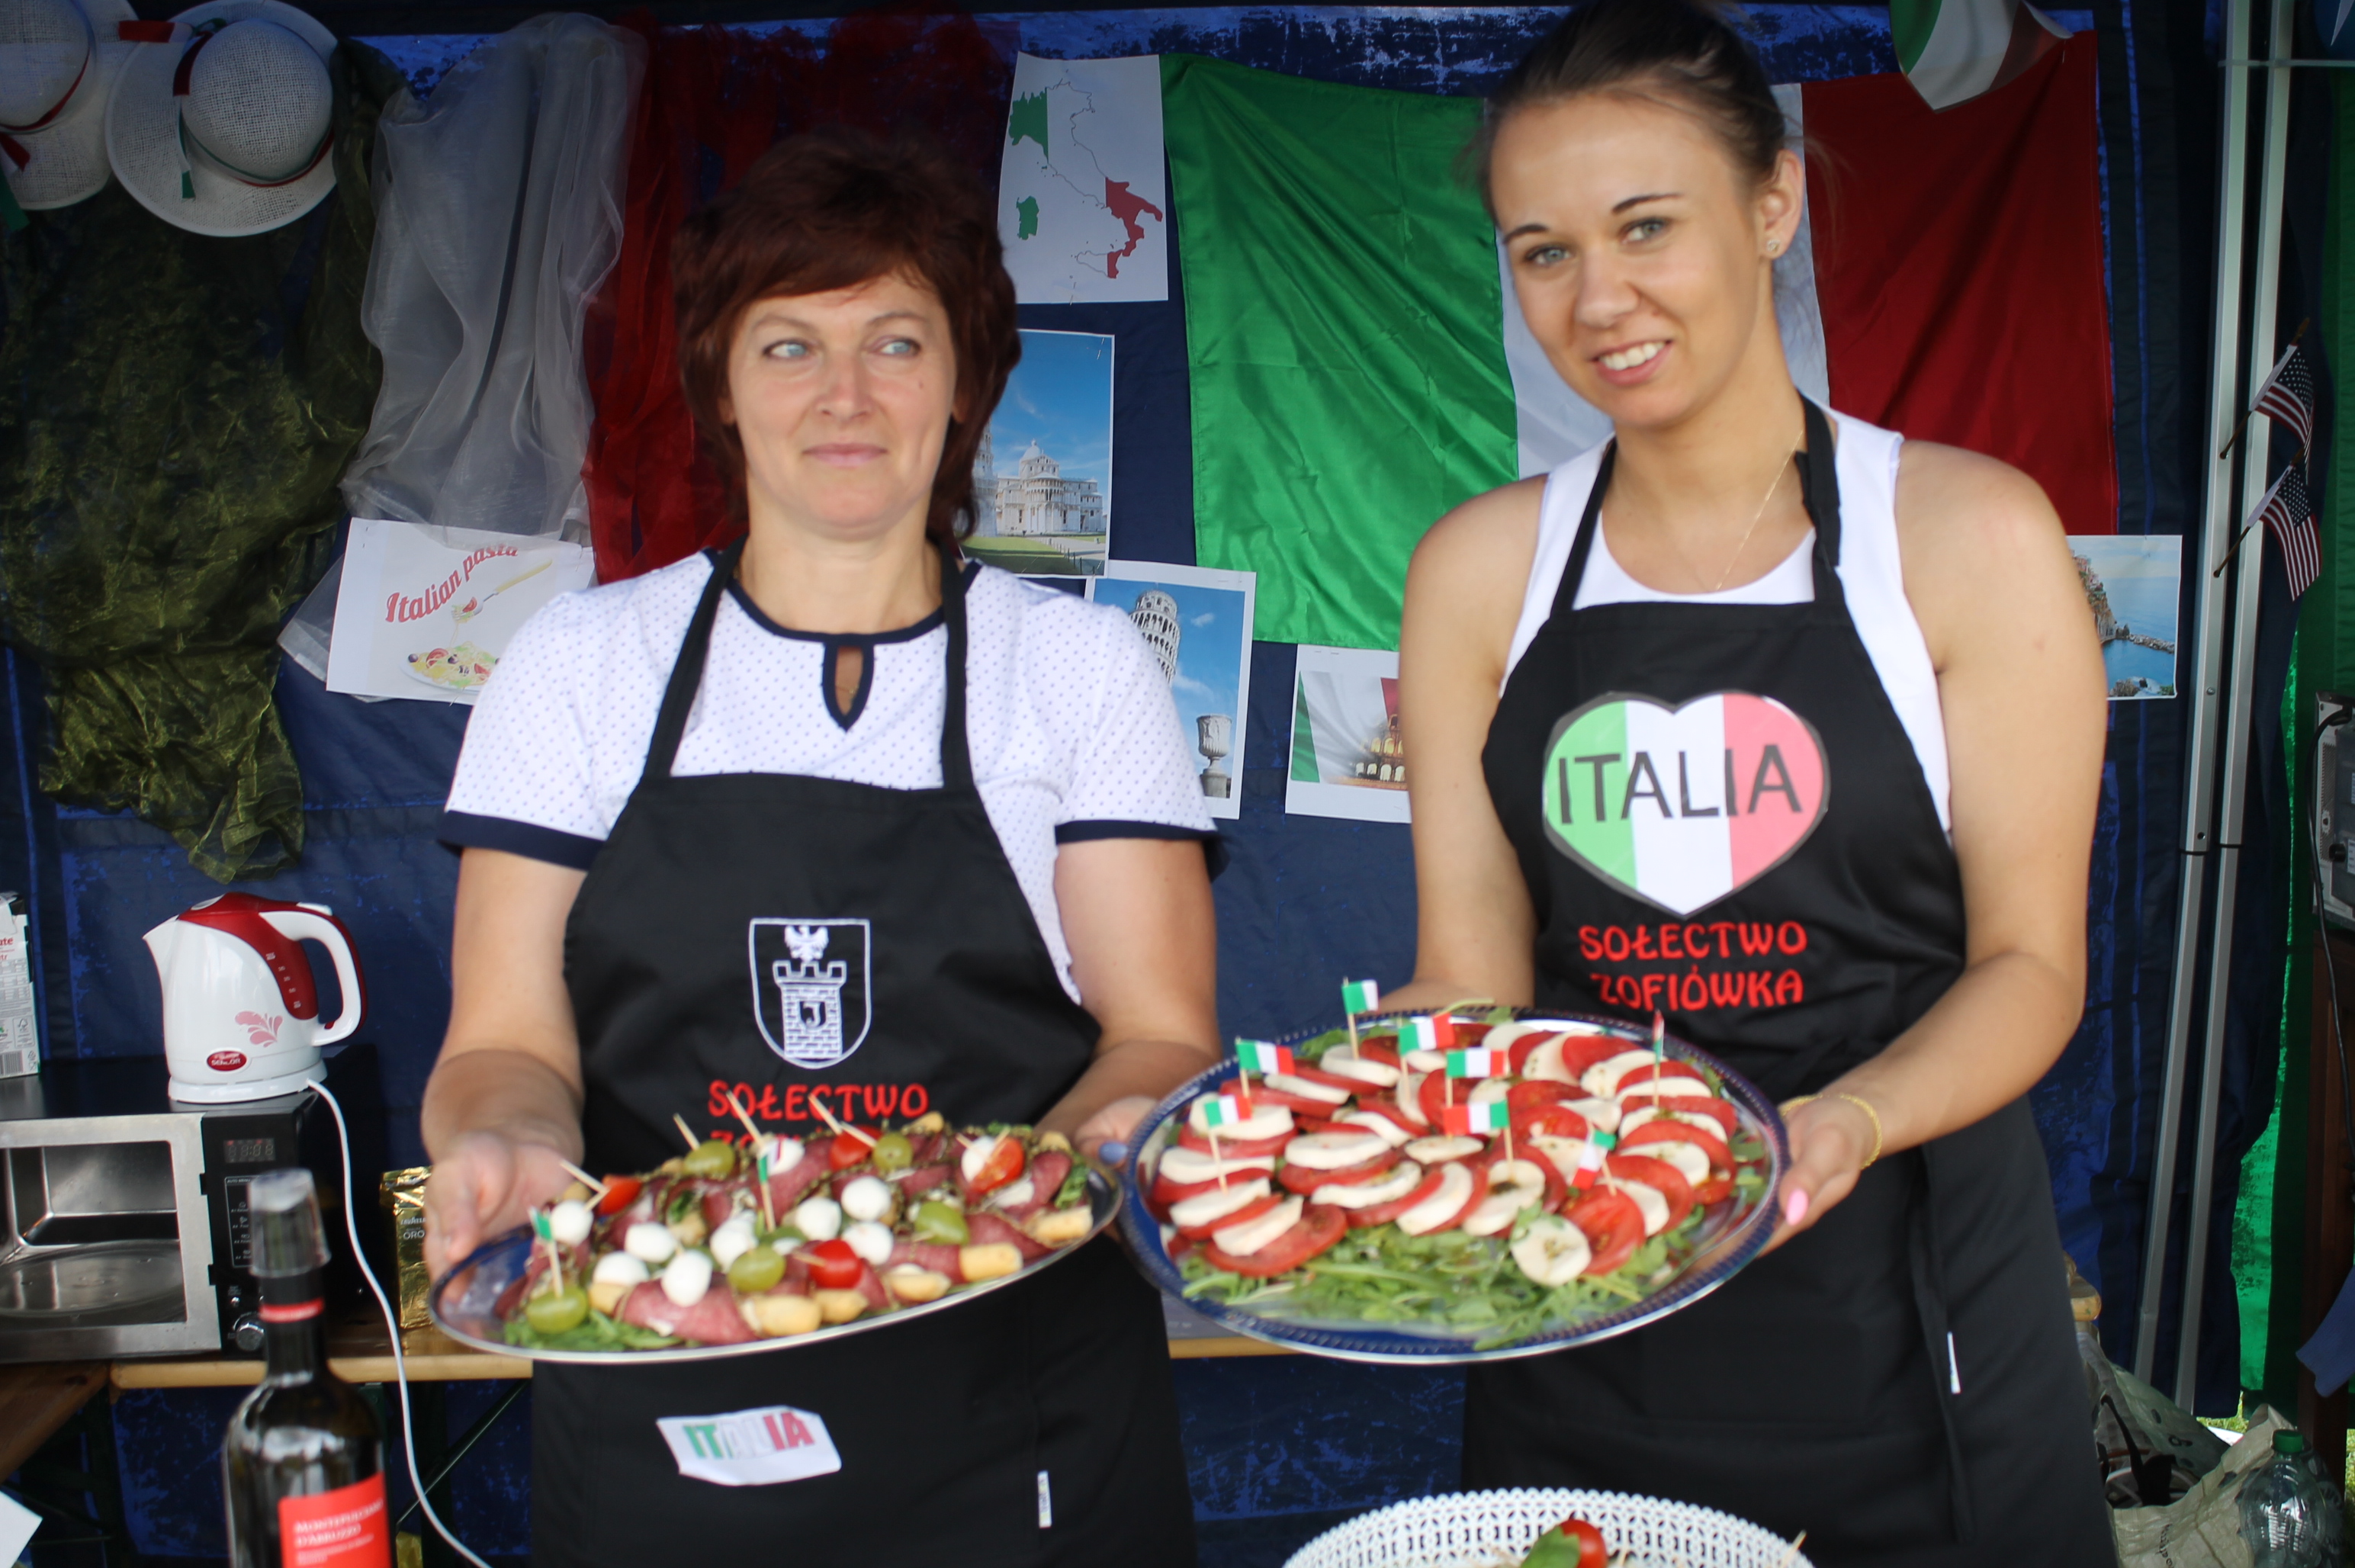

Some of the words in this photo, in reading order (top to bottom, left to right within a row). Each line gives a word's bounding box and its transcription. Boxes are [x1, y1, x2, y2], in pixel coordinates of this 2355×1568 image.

[385, 569, 462, 623] Italian
[462, 543, 519, 583] pasta
[1558, 744, 1803, 824] ITALIA
[1578, 921, 1808, 962] SOŁECTWO
[1589, 964, 1804, 1011] ZOFIÓWKA
[708, 1079, 929, 1122] SOŁECTWO
[403, 1230, 426, 1240] ORO
[683, 1411, 816, 1460] ITALIA
